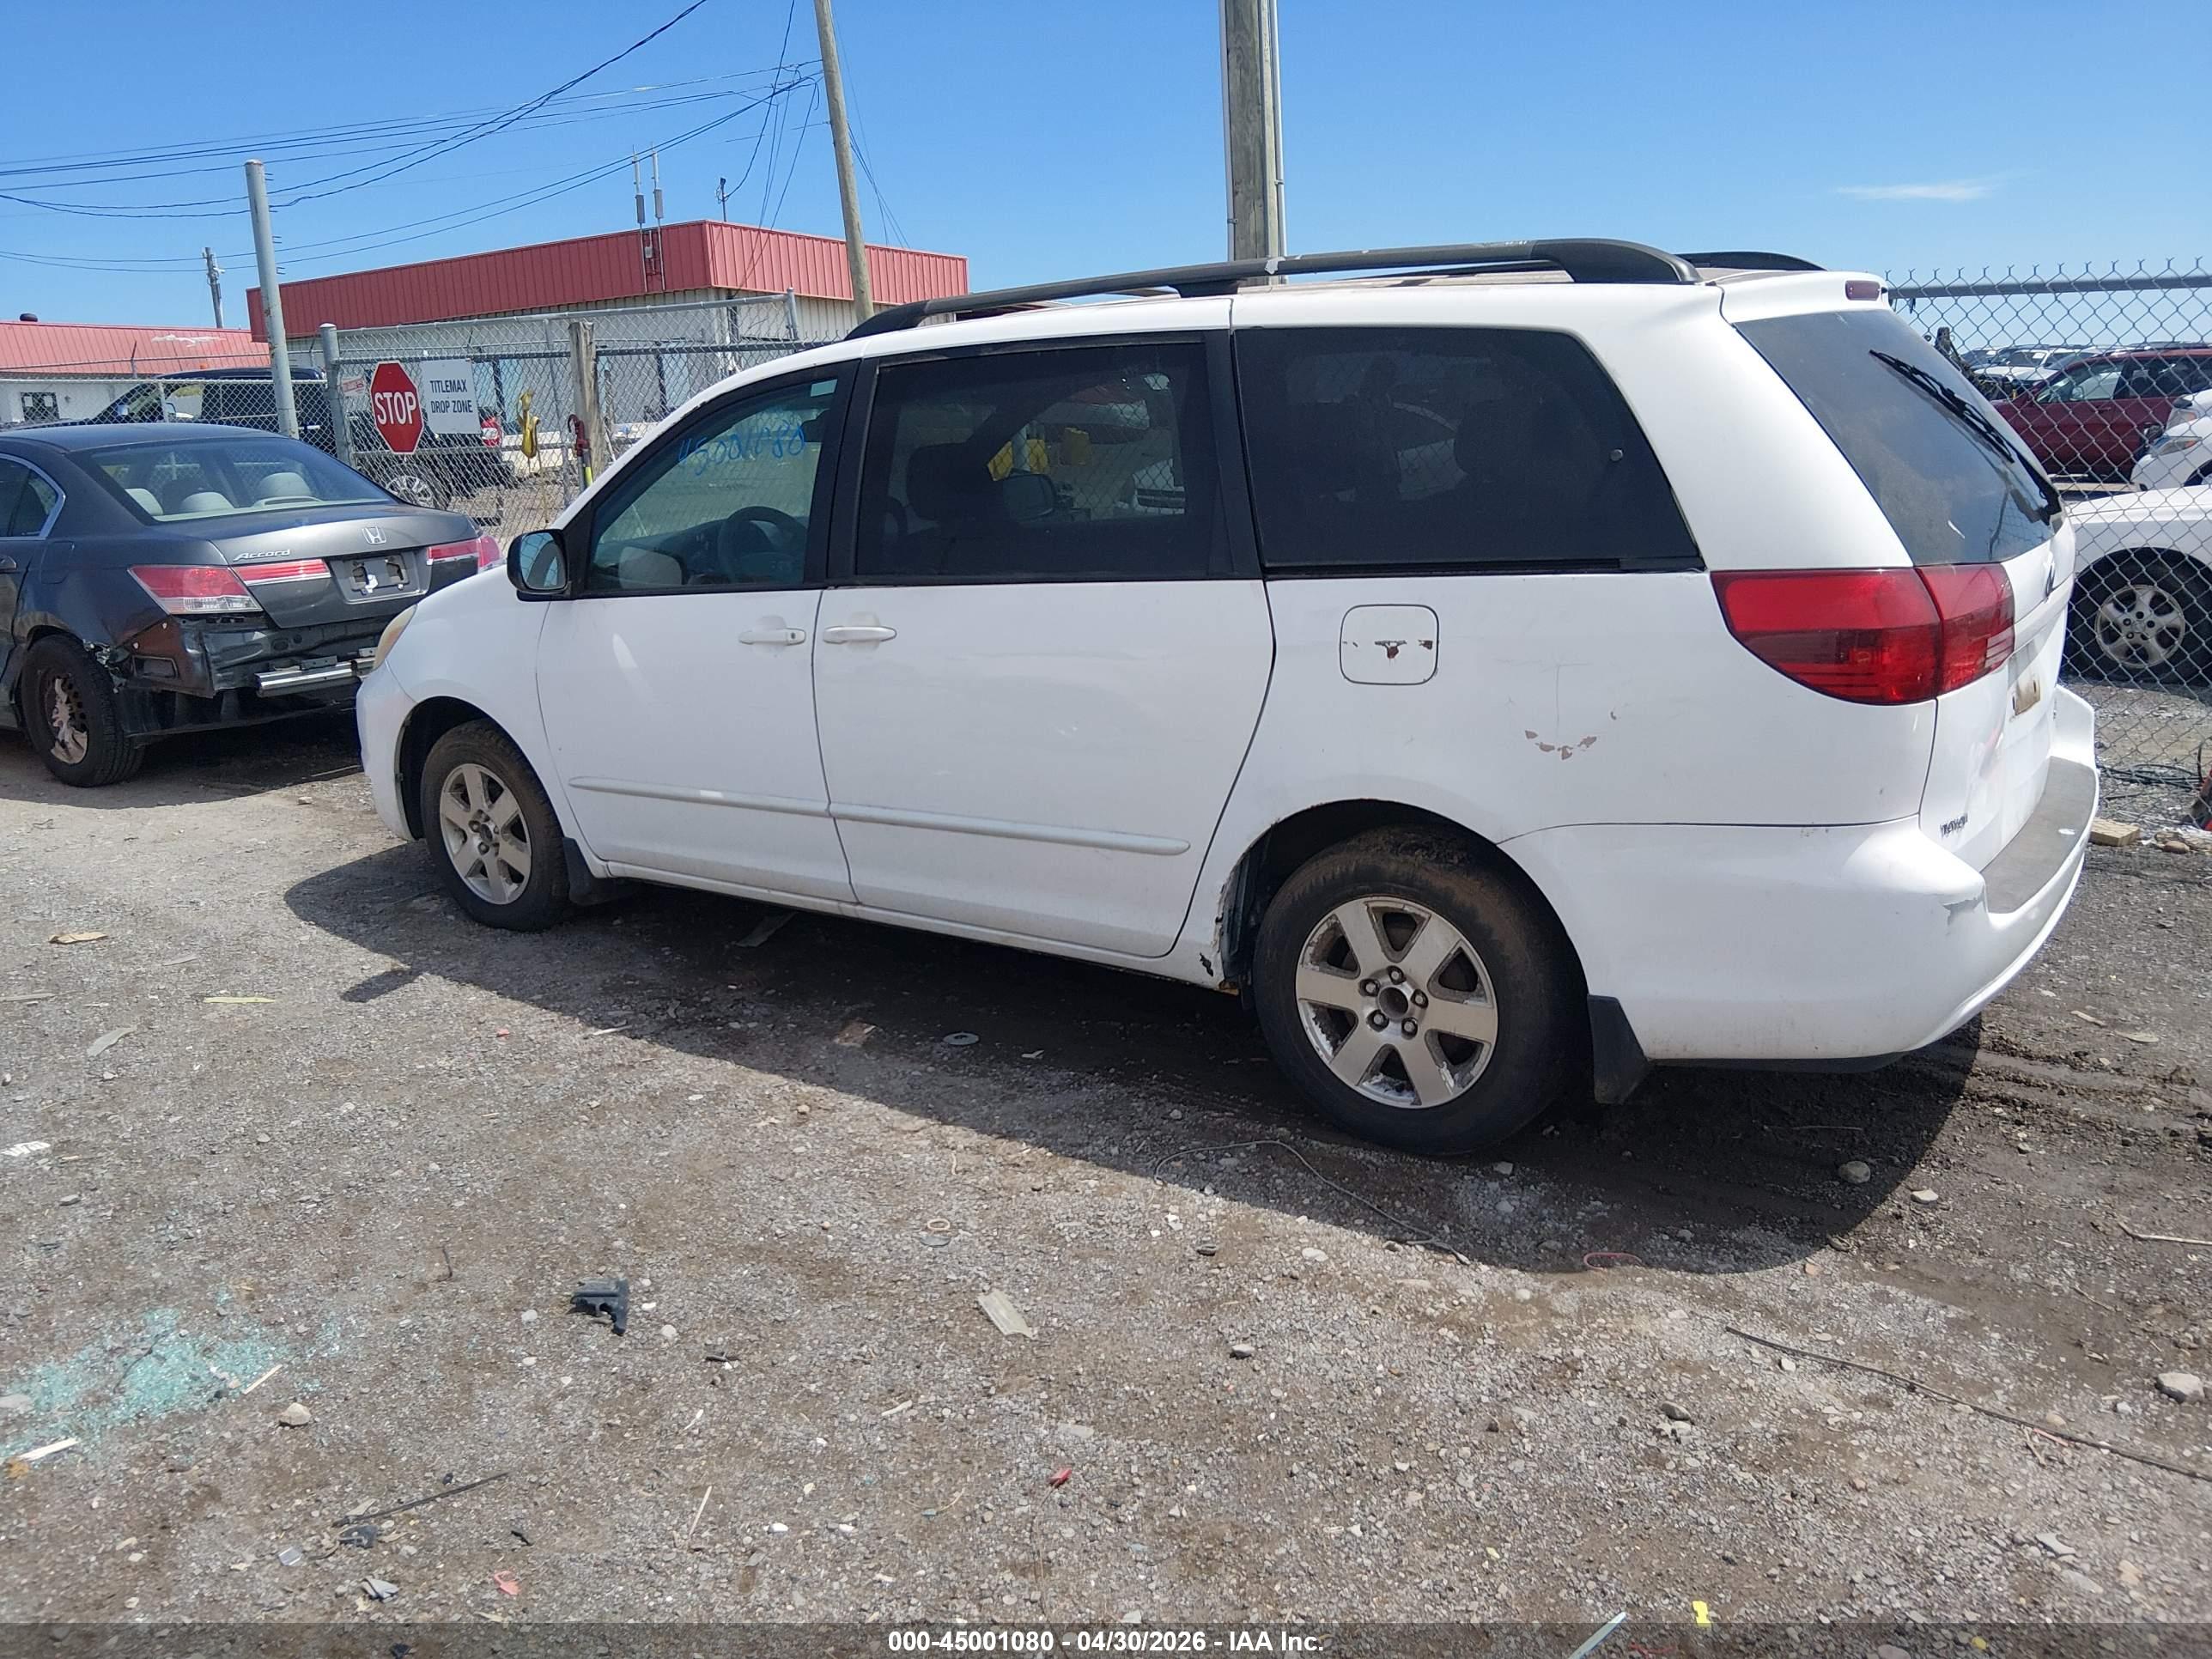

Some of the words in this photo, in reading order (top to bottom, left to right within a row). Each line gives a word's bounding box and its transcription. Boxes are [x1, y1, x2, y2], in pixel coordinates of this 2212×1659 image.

[429, 380, 468, 393] TITLEMAX
[374, 392, 416, 425] STOP
[430, 400, 450, 414] DROP
[453, 399, 473, 413] ZONE
[233, 549, 290, 562] Accord
